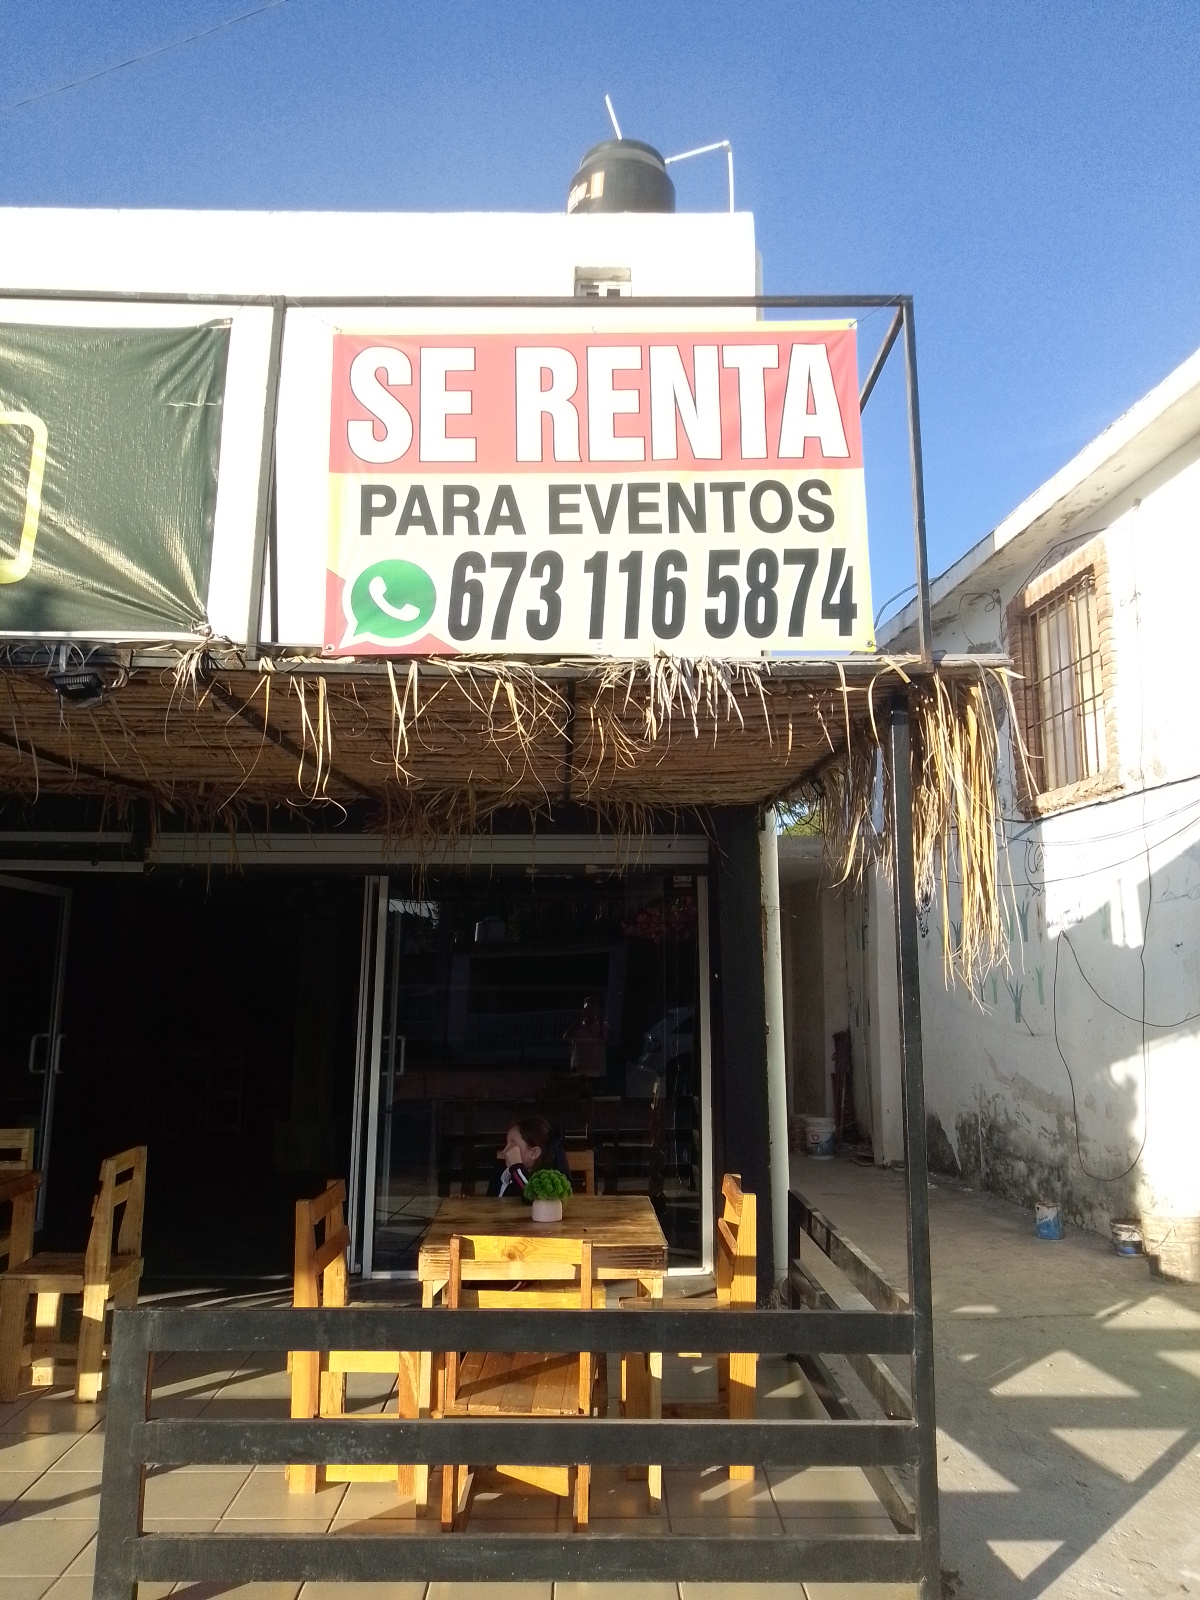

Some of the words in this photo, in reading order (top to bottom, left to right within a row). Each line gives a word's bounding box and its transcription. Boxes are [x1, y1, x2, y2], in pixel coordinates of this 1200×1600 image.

[346, 346, 477, 464] SE
[514, 343, 851, 463] RENTA
[359, 484, 527, 536] PARA
[548, 479, 836, 535] EVENTOS
[447, 550, 565, 641] 673
[583, 548, 690, 640] 116
[704, 547, 858, 638] 5874
